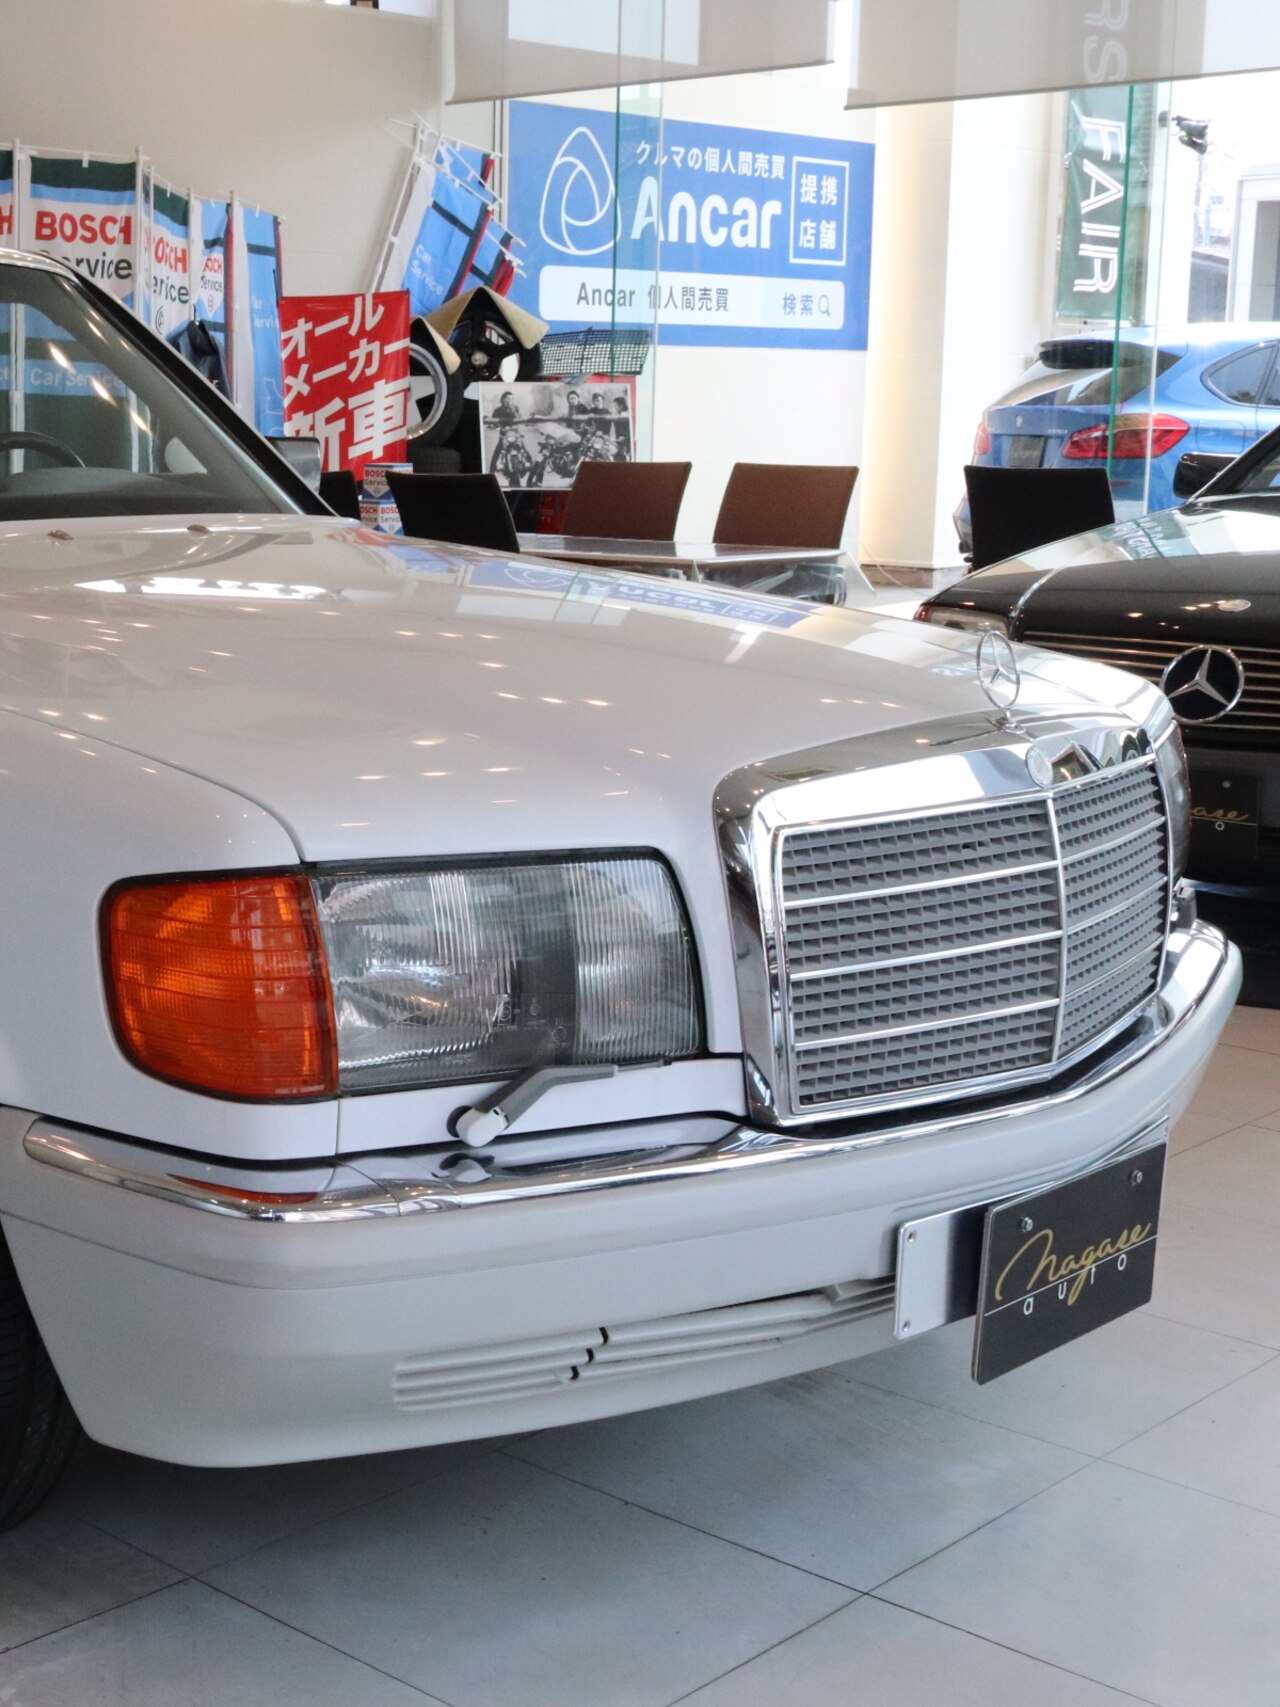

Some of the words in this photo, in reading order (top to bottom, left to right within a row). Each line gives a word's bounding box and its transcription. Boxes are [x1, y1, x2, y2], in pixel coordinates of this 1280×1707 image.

[636, 140, 785, 180] クルマの個人間売買
[800, 173, 838, 206] 提携
[1073, 117, 1125, 294] FAIR
[35, 210, 132, 245] BOSCH
[631, 176, 782, 249] Ancar
[798, 218, 837, 250] 店舗
[40, 250, 132, 279] rvice
[416, 244, 432, 264] Car
[411, 260, 444, 295] Service
[577, 282, 635, 308] Ancar
[648, 283, 729, 313] 個人間売買
[783, 292, 814, 316] 検索
[281, 294, 385, 360] オール
[30, 368, 60, 386] Car
[284, 337, 410, 408] メーカー
[284, 377, 410, 472] 新車
[365, 470, 385, 478] BOSC
[995, 1222, 1152, 1306] Nagase
[1023, 1253, 1127, 1316] auto
